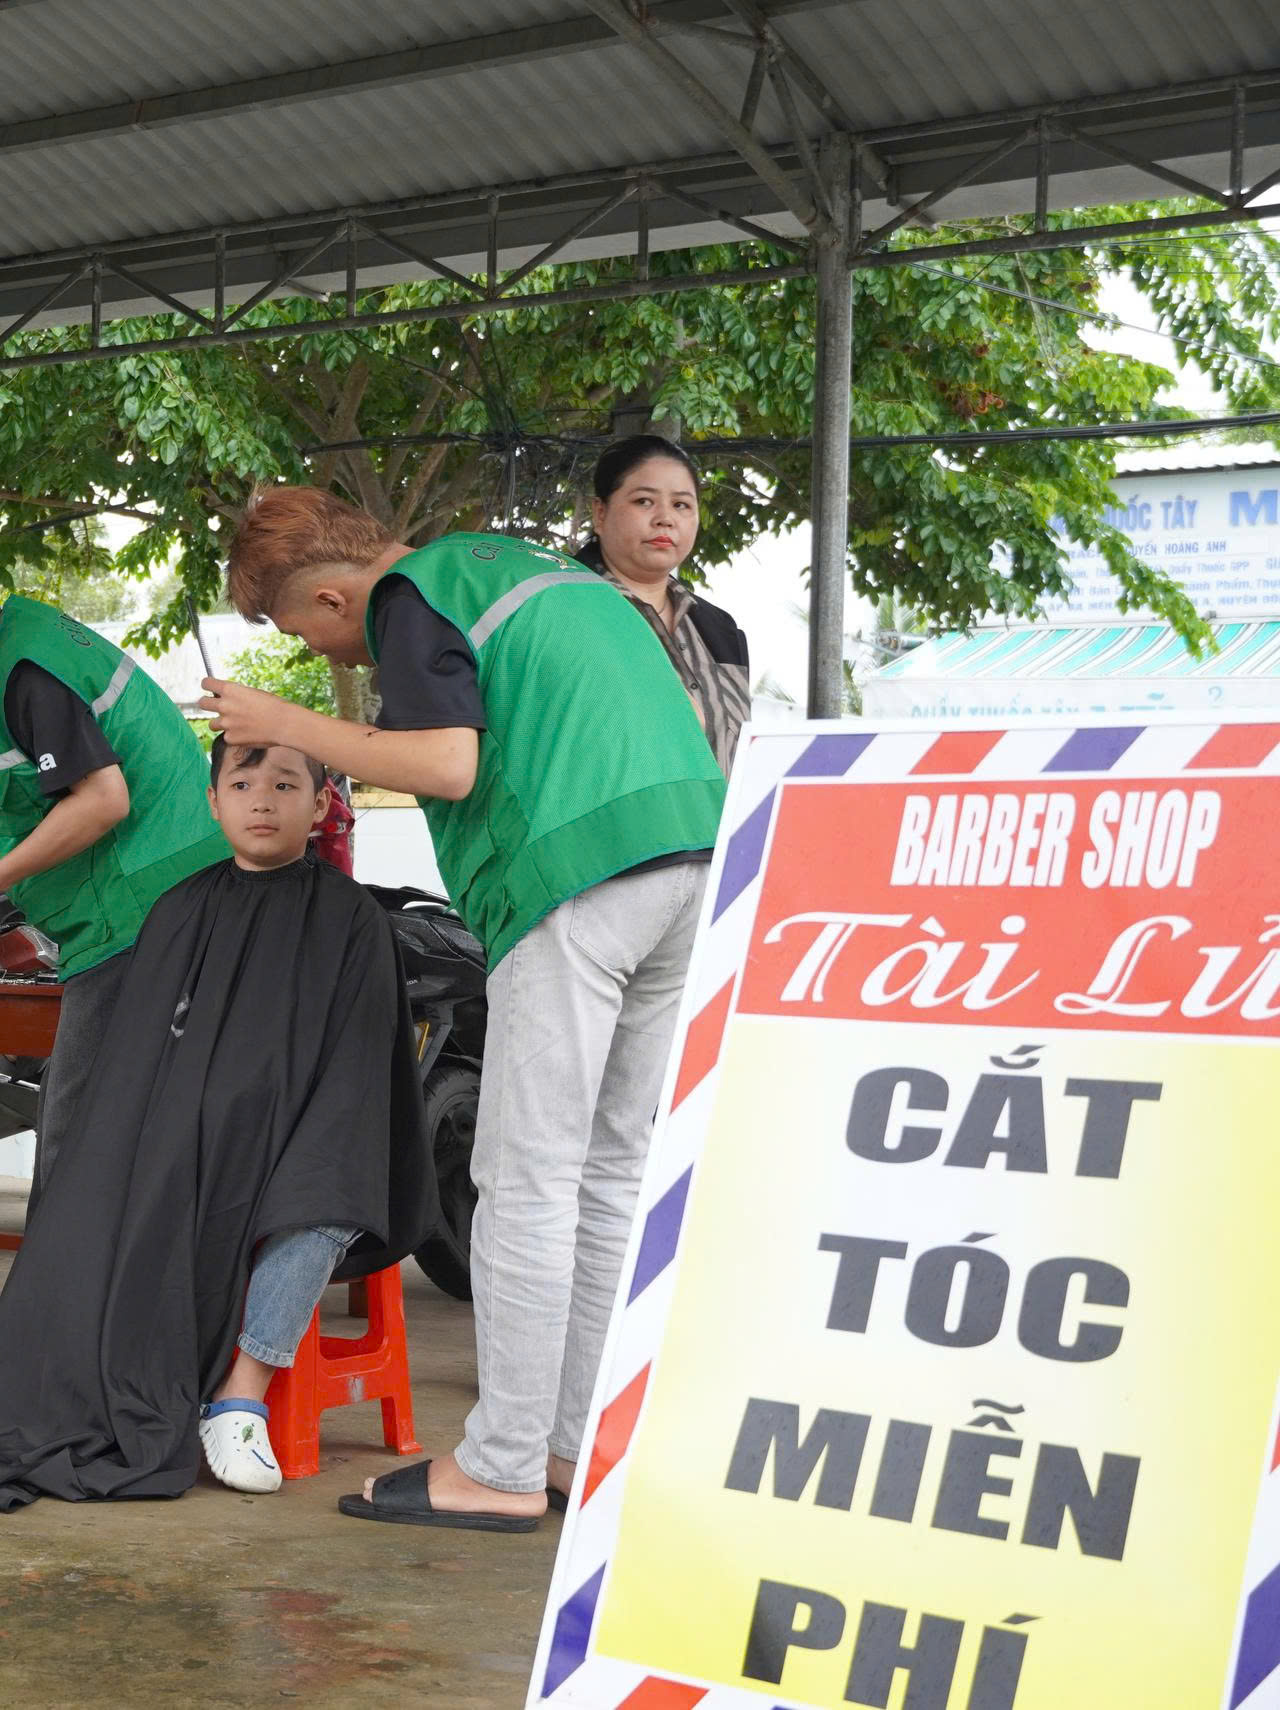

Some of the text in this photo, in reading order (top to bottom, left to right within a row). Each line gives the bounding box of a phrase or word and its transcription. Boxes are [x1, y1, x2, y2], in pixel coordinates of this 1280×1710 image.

[1160, 494, 1198, 529] TÂY
[889, 788, 1222, 889] BARBER SHOP
[763, 911, 1040, 1011] Tài
[845, 1044, 1164, 1180] CẮT
[817, 1231, 1131, 1364] TÓC
[723, 1397, 1142, 1563] MIỄN
[741, 1578, 1044, 1710] PHÍ
